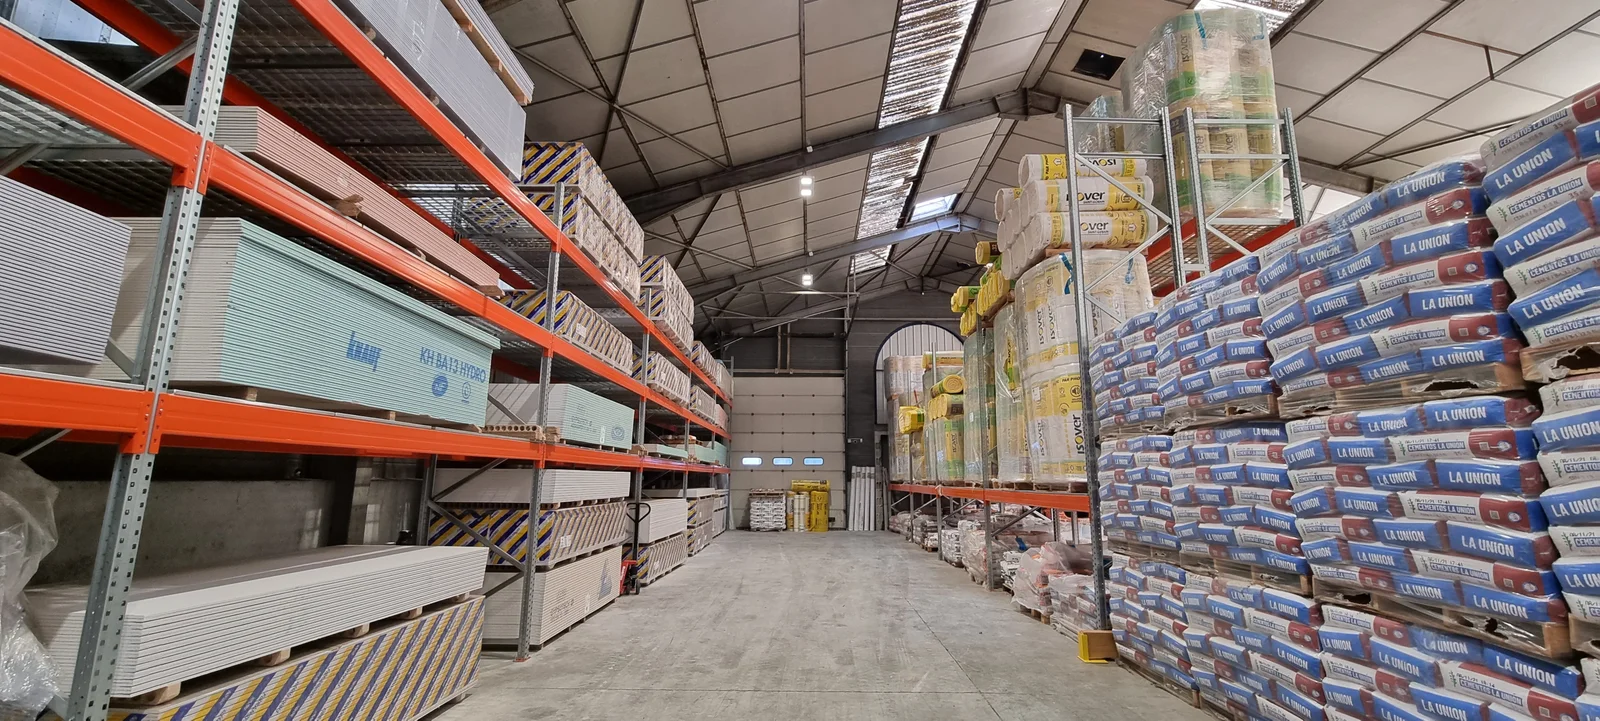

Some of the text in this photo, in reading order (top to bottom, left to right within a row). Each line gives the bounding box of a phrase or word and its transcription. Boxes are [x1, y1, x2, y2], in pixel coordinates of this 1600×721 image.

[1532, 120, 1542, 130] LA
[1495, 148, 1553, 189] LA UNION
[1396, 172, 1445, 198] LA UNION
[1509, 194, 1546, 215] CEMENTOS
[1546, 188, 1558, 198] LA
[1348, 202, 1373, 224] UNION
[1403, 233, 1450, 255] LA UNION
[1505, 217, 1567, 256] LA UNION
[1305, 245, 1341, 265] LA UNION
[1226, 264, 1249, 278] LA UNION
[1260, 262, 1288, 285] LA UNION
[1337, 255, 1372, 279] LA UNION
[1529, 260, 1568, 278] CEMENTOS
[1569, 254, 1580, 264] LA
[1408, 274, 1416, 283] LA
[1227, 304, 1250, 315] LA UNION
[1313, 295, 1348, 315] LA UNION
[1422, 293, 1473, 310] LA UNION
[1522, 283, 1585, 319] LA UNION
[1267, 312, 1295, 334] LA UNION
[1354, 307, 1394, 329] LA UNION
[1419, 332, 1427, 340] LA
[1544, 320, 1583, 338] CEMENTOS
[1584, 317, 1595, 326] LA
[1231, 346, 1255, 355] LA UNION
[1325, 346, 1364, 365] LA UNION
[1432, 350, 1485, 367] LA UNION
[420, 346, 486, 383] KH BA13 HYDRO
[1275, 358, 1305, 379] LA UNION
[1368, 361, 1410, 380] LA UNION
[1237, 385, 1262, 395] LA UNION
[1562, 389, 1600, 401] CEMENTOS
[1435, 406, 1487, 422] LA UNION
[1253, 427, 1280, 436] LA UNION
[1368, 417, 1408, 432] LA UNION
[1542, 421, 1600, 443] LA UNION
[1337, 447, 1375, 458] LA UNION
[1408, 443, 1437, 452] CEMENTOS
[1437, 442, 1446, 450] LA
[1252, 472, 1280, 483] LA UNION
[1377, 470, 1417, 486] LA UNION
[1449, 471, 1501, 485] LA UNION
[1343, 499, 1378, 512] LA UNION
[1417, 503, 1447, 512] CEMENTOS
[1447, 505, 1456, 513] LA
[1551, 498, 1600, 517] LA UNIO
[1261, 515, 1290, 530] LA UNION
[1384, 529, 1426, 542] LA UNION
[1461, 535, 1514, 558] LA UNION
[1357, 552, 1394, 566] LA UNION
[1460, 568, 1470, 576] LA
[1565, 574, 1585, 588] LA
[1400, 583, 1443, 600] LA UNION
[1270, 600, 1299, 617] LA UNION
[1473, 595, 1529, 619] LA UNION
[1323, 638, 1352, 651] LA UNION
[1423, 638, 1468, 654] LA UNION
[1277, 648, 1308, 670] LA UNION
[1379, 652, 1420, 677] LA UNION
[1496, 656, 1512, 672] LA
[1514, 661, 1555, 687] UNION
[1491, 688, 1501, 699] LA
[1381, 708, 1393, 721] LA
[1421, 699, 1467, 721] LA UNION
